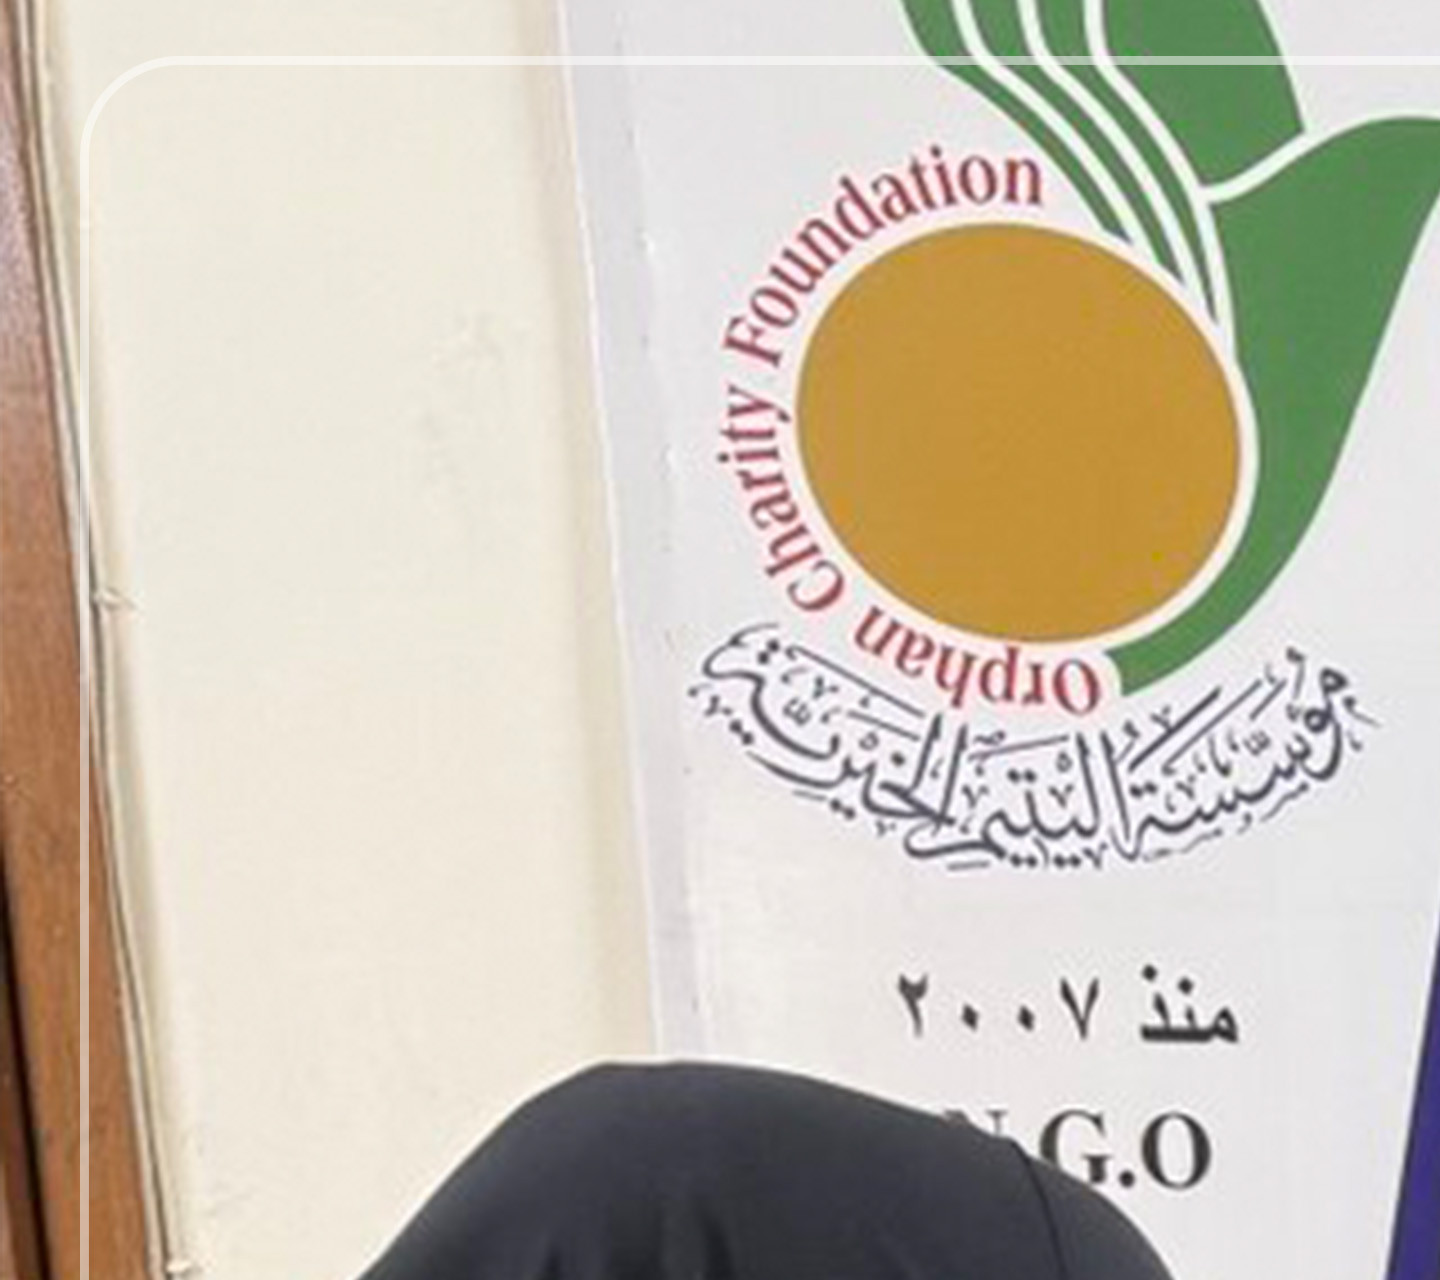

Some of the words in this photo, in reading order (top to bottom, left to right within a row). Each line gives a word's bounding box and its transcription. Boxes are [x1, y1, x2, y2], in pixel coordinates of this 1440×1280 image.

[722, 145, 1045, 369] Foundation
[717, 382, 848, 615] Charity
[854, 604, 1101, 719] Orphan
[898, 973, 1100, 1039] ٢٠٠٧
[1140, 963, 1239, 1043] منذ
